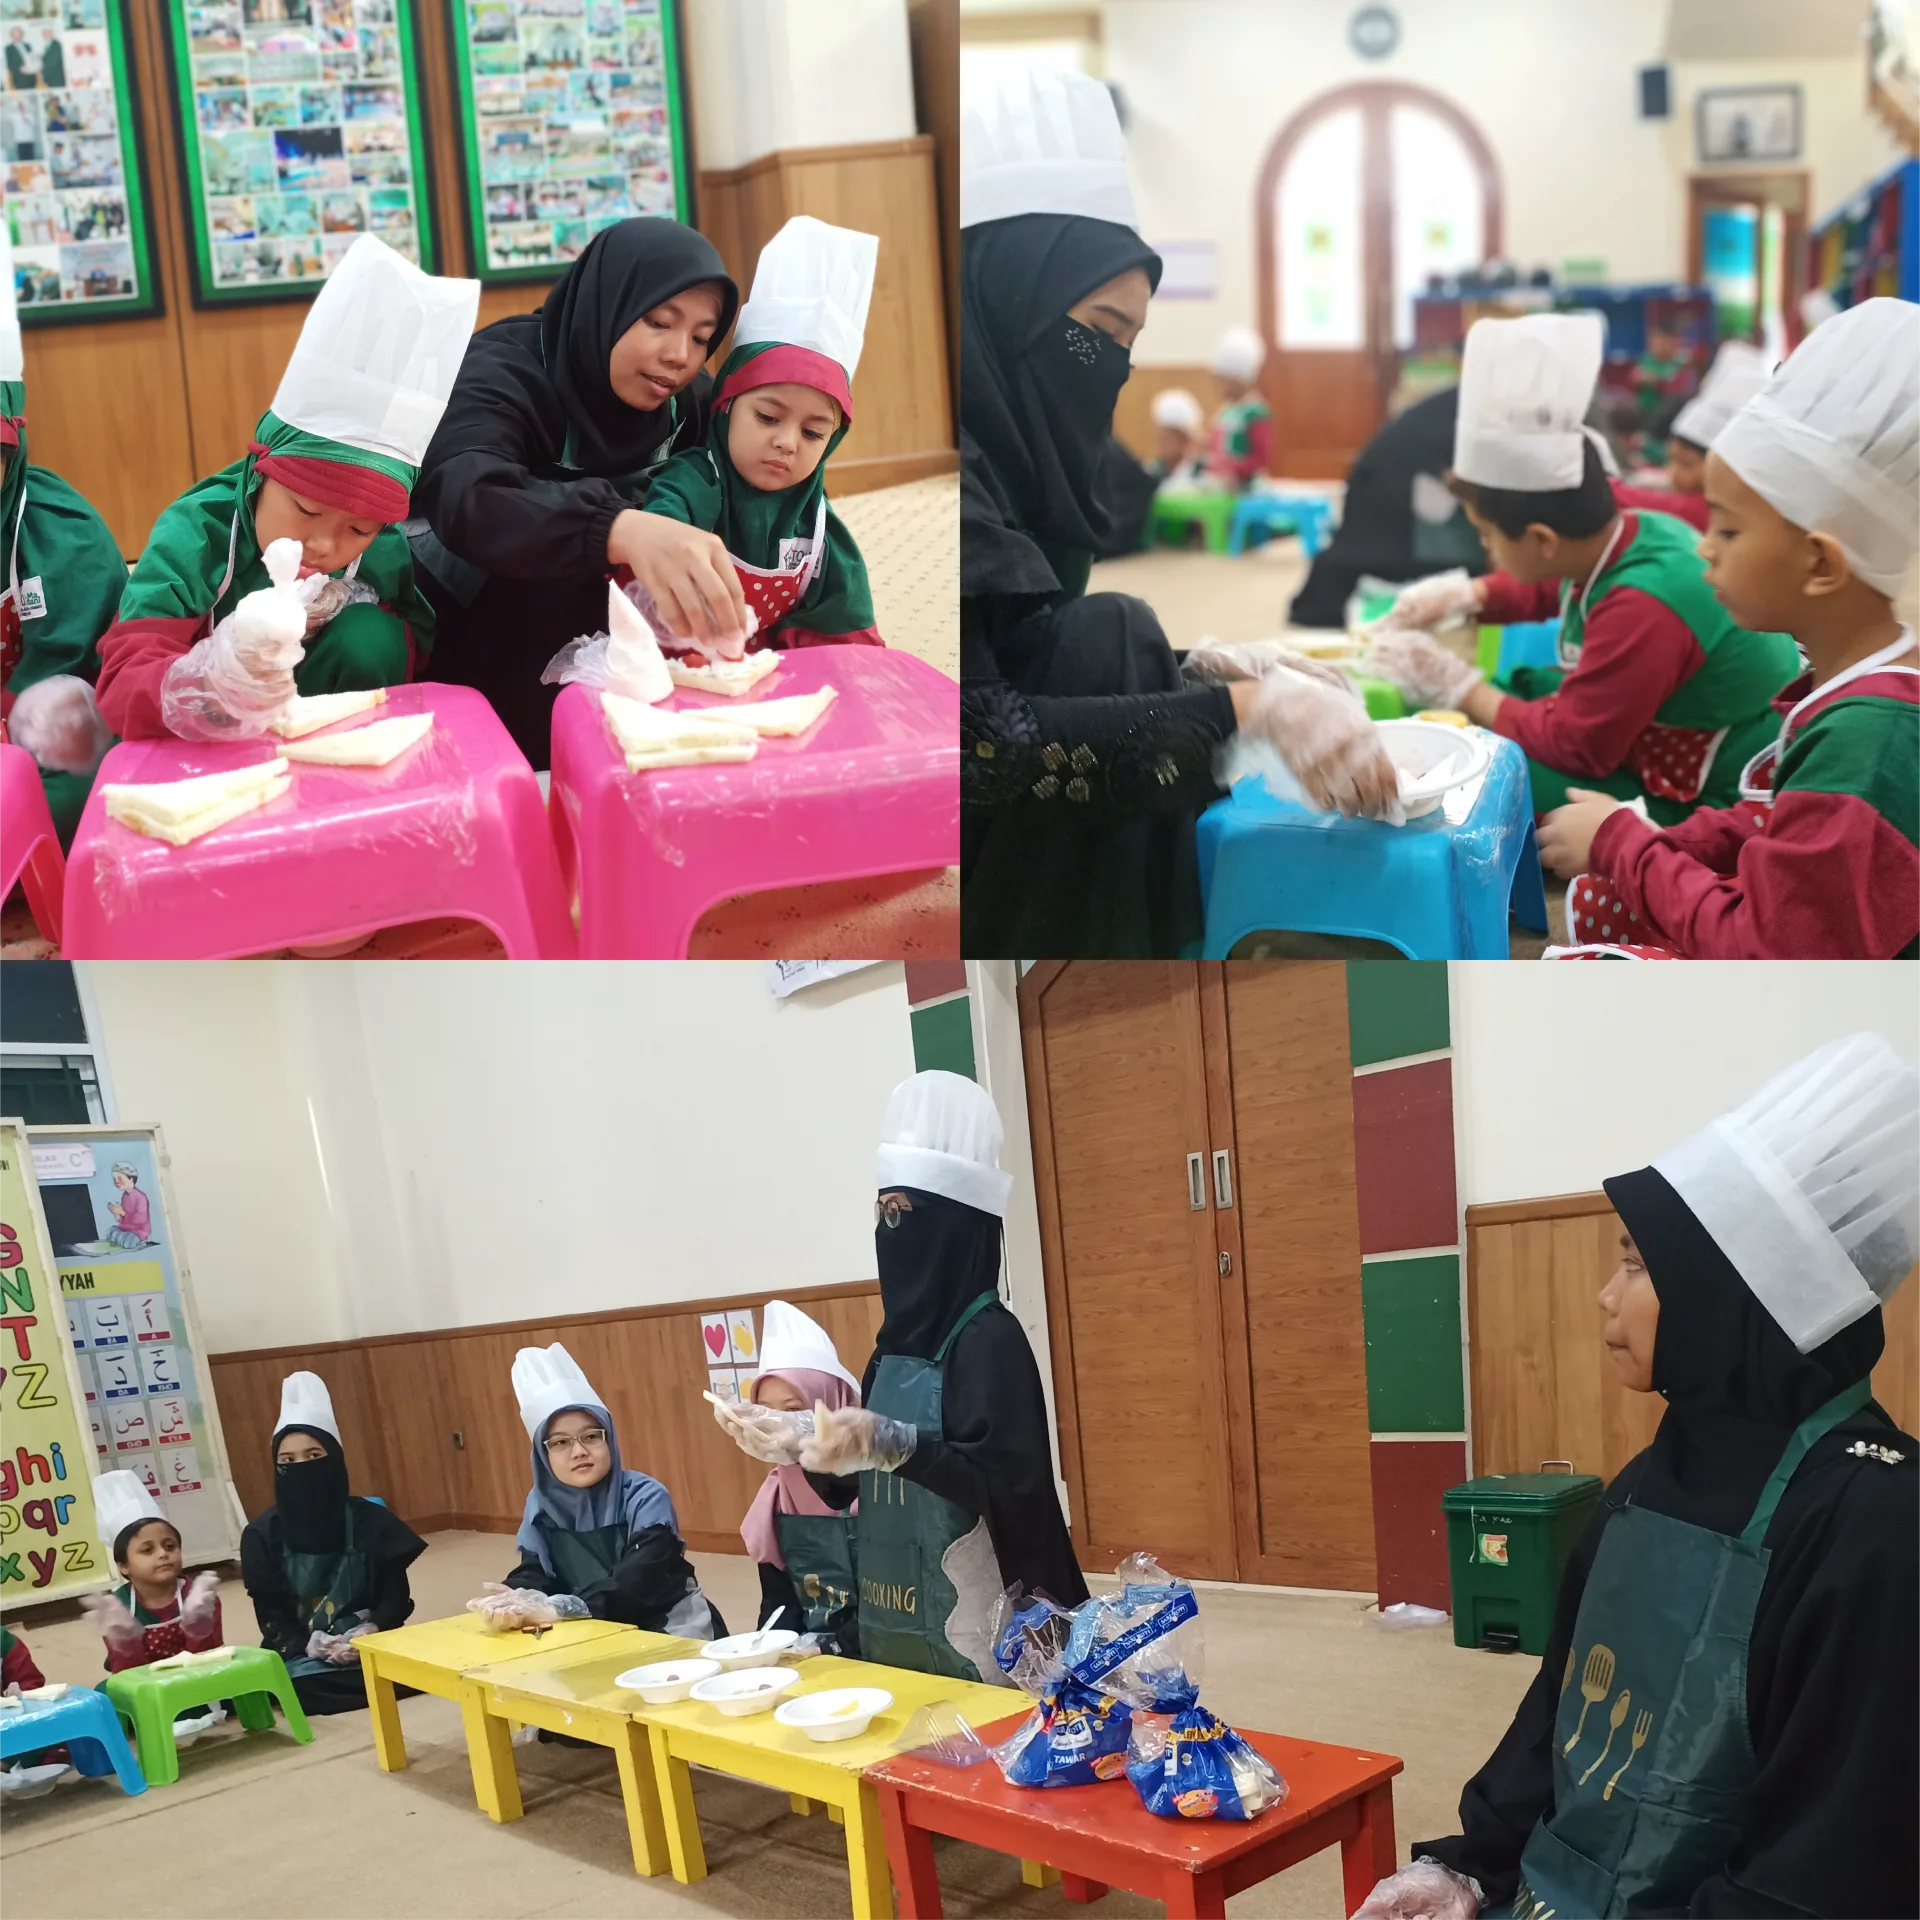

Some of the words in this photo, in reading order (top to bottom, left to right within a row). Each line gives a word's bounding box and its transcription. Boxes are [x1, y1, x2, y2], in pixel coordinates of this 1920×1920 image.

[0, 1315, 37, 1361] T
[0, 1442, 67, 1500] ghi
[0, 1494, 76, 1546] pqr
[0, 1541, 94, 1588] xyz
[861, 1577, 916, 1615] COOKING
[1054, 1752, 1086, 1764] TAWAR
